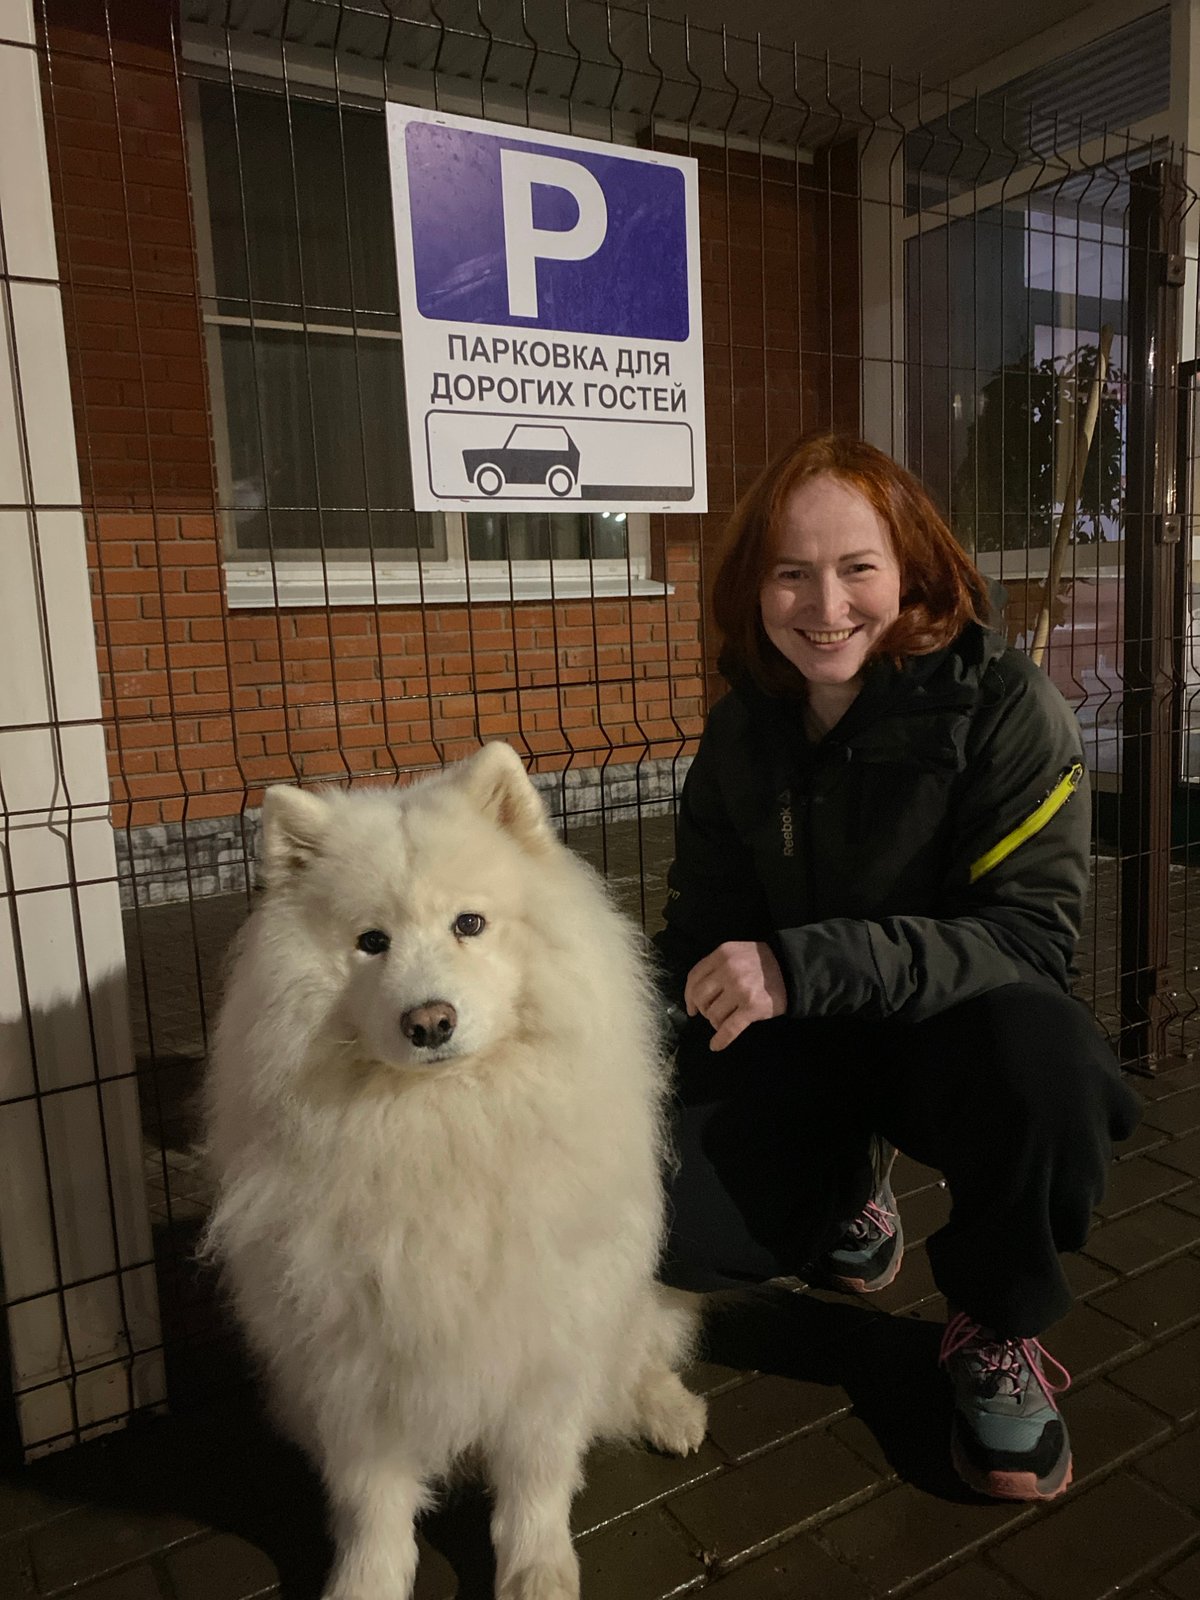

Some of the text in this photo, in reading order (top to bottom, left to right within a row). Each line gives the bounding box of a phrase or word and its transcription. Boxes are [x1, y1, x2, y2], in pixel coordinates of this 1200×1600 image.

[500, 147, 608, 319] P
[448, 333, 671, 379] ПАРКОВКА ДЛЯ
[430, 372, 687, 413] ДОРОГИХ ГОСТЕЙ
[779, 805, 794, 857] Reebok
